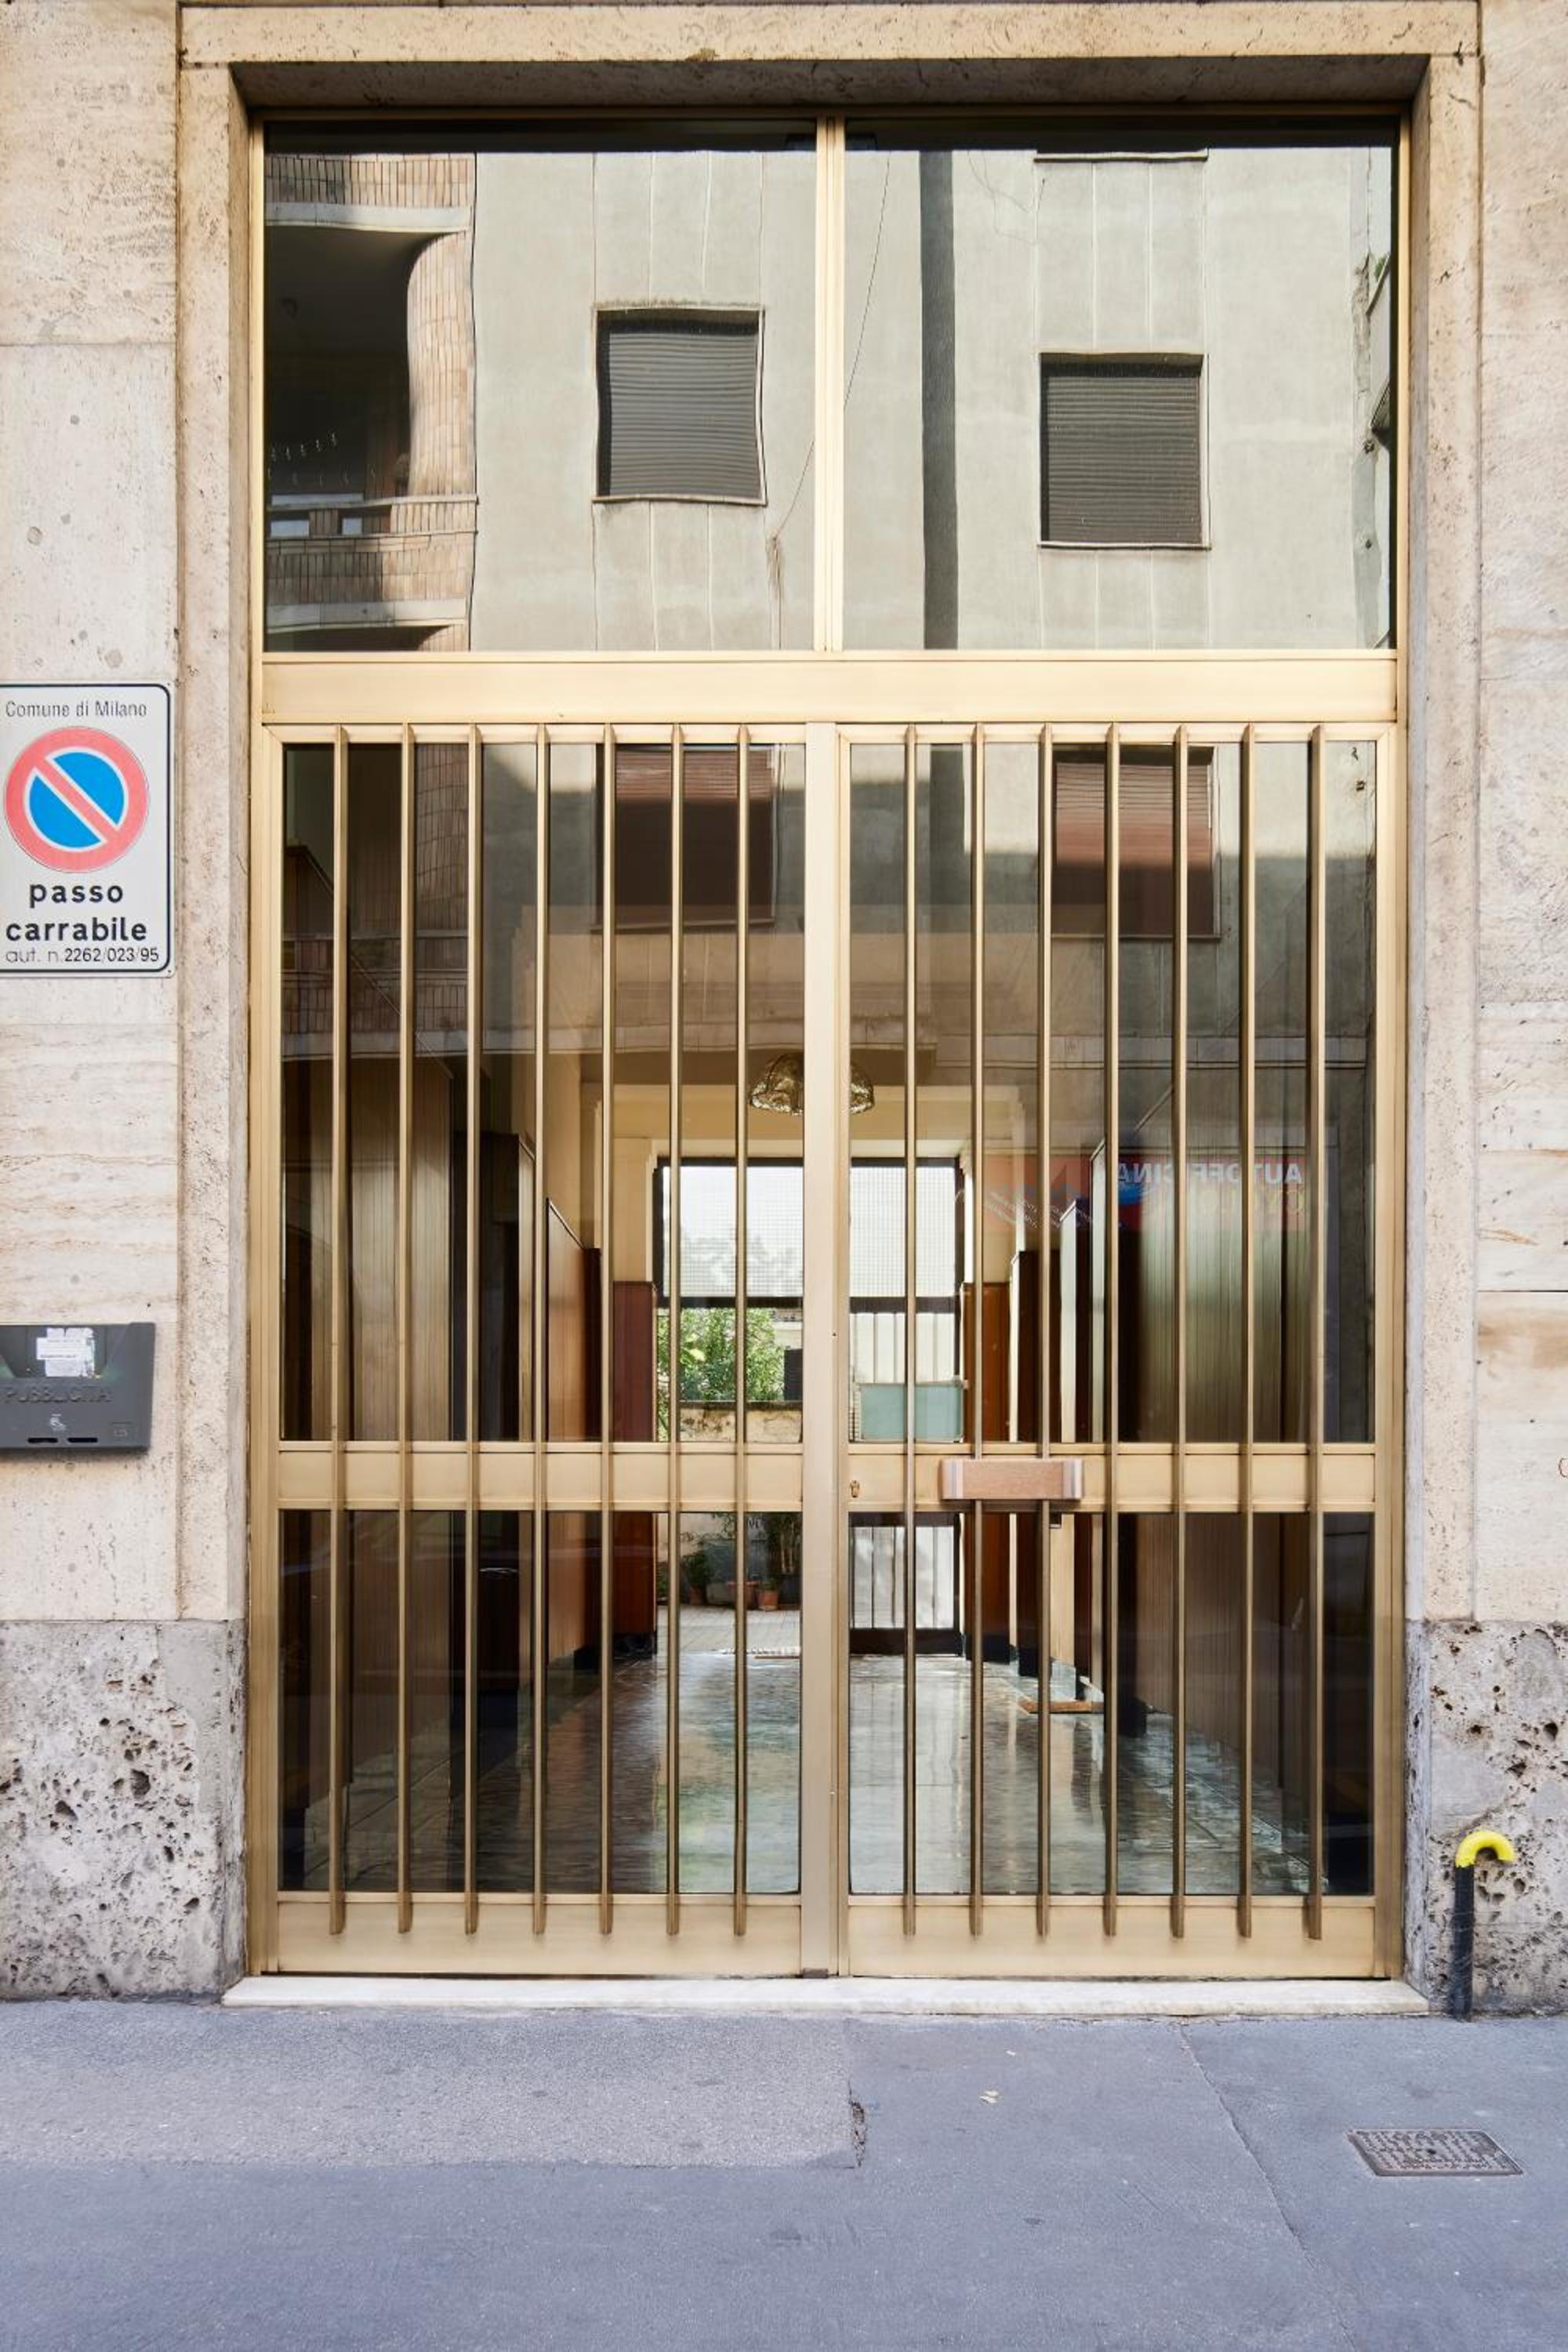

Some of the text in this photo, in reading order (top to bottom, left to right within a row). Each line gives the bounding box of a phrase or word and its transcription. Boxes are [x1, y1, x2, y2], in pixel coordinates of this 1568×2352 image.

[5, 700, 147, 717] Comune di Milano
[29, 884, 124, 908] passo
[5, 916, 147, 942] carrabile
[5, 950, 41, 964] aut.
